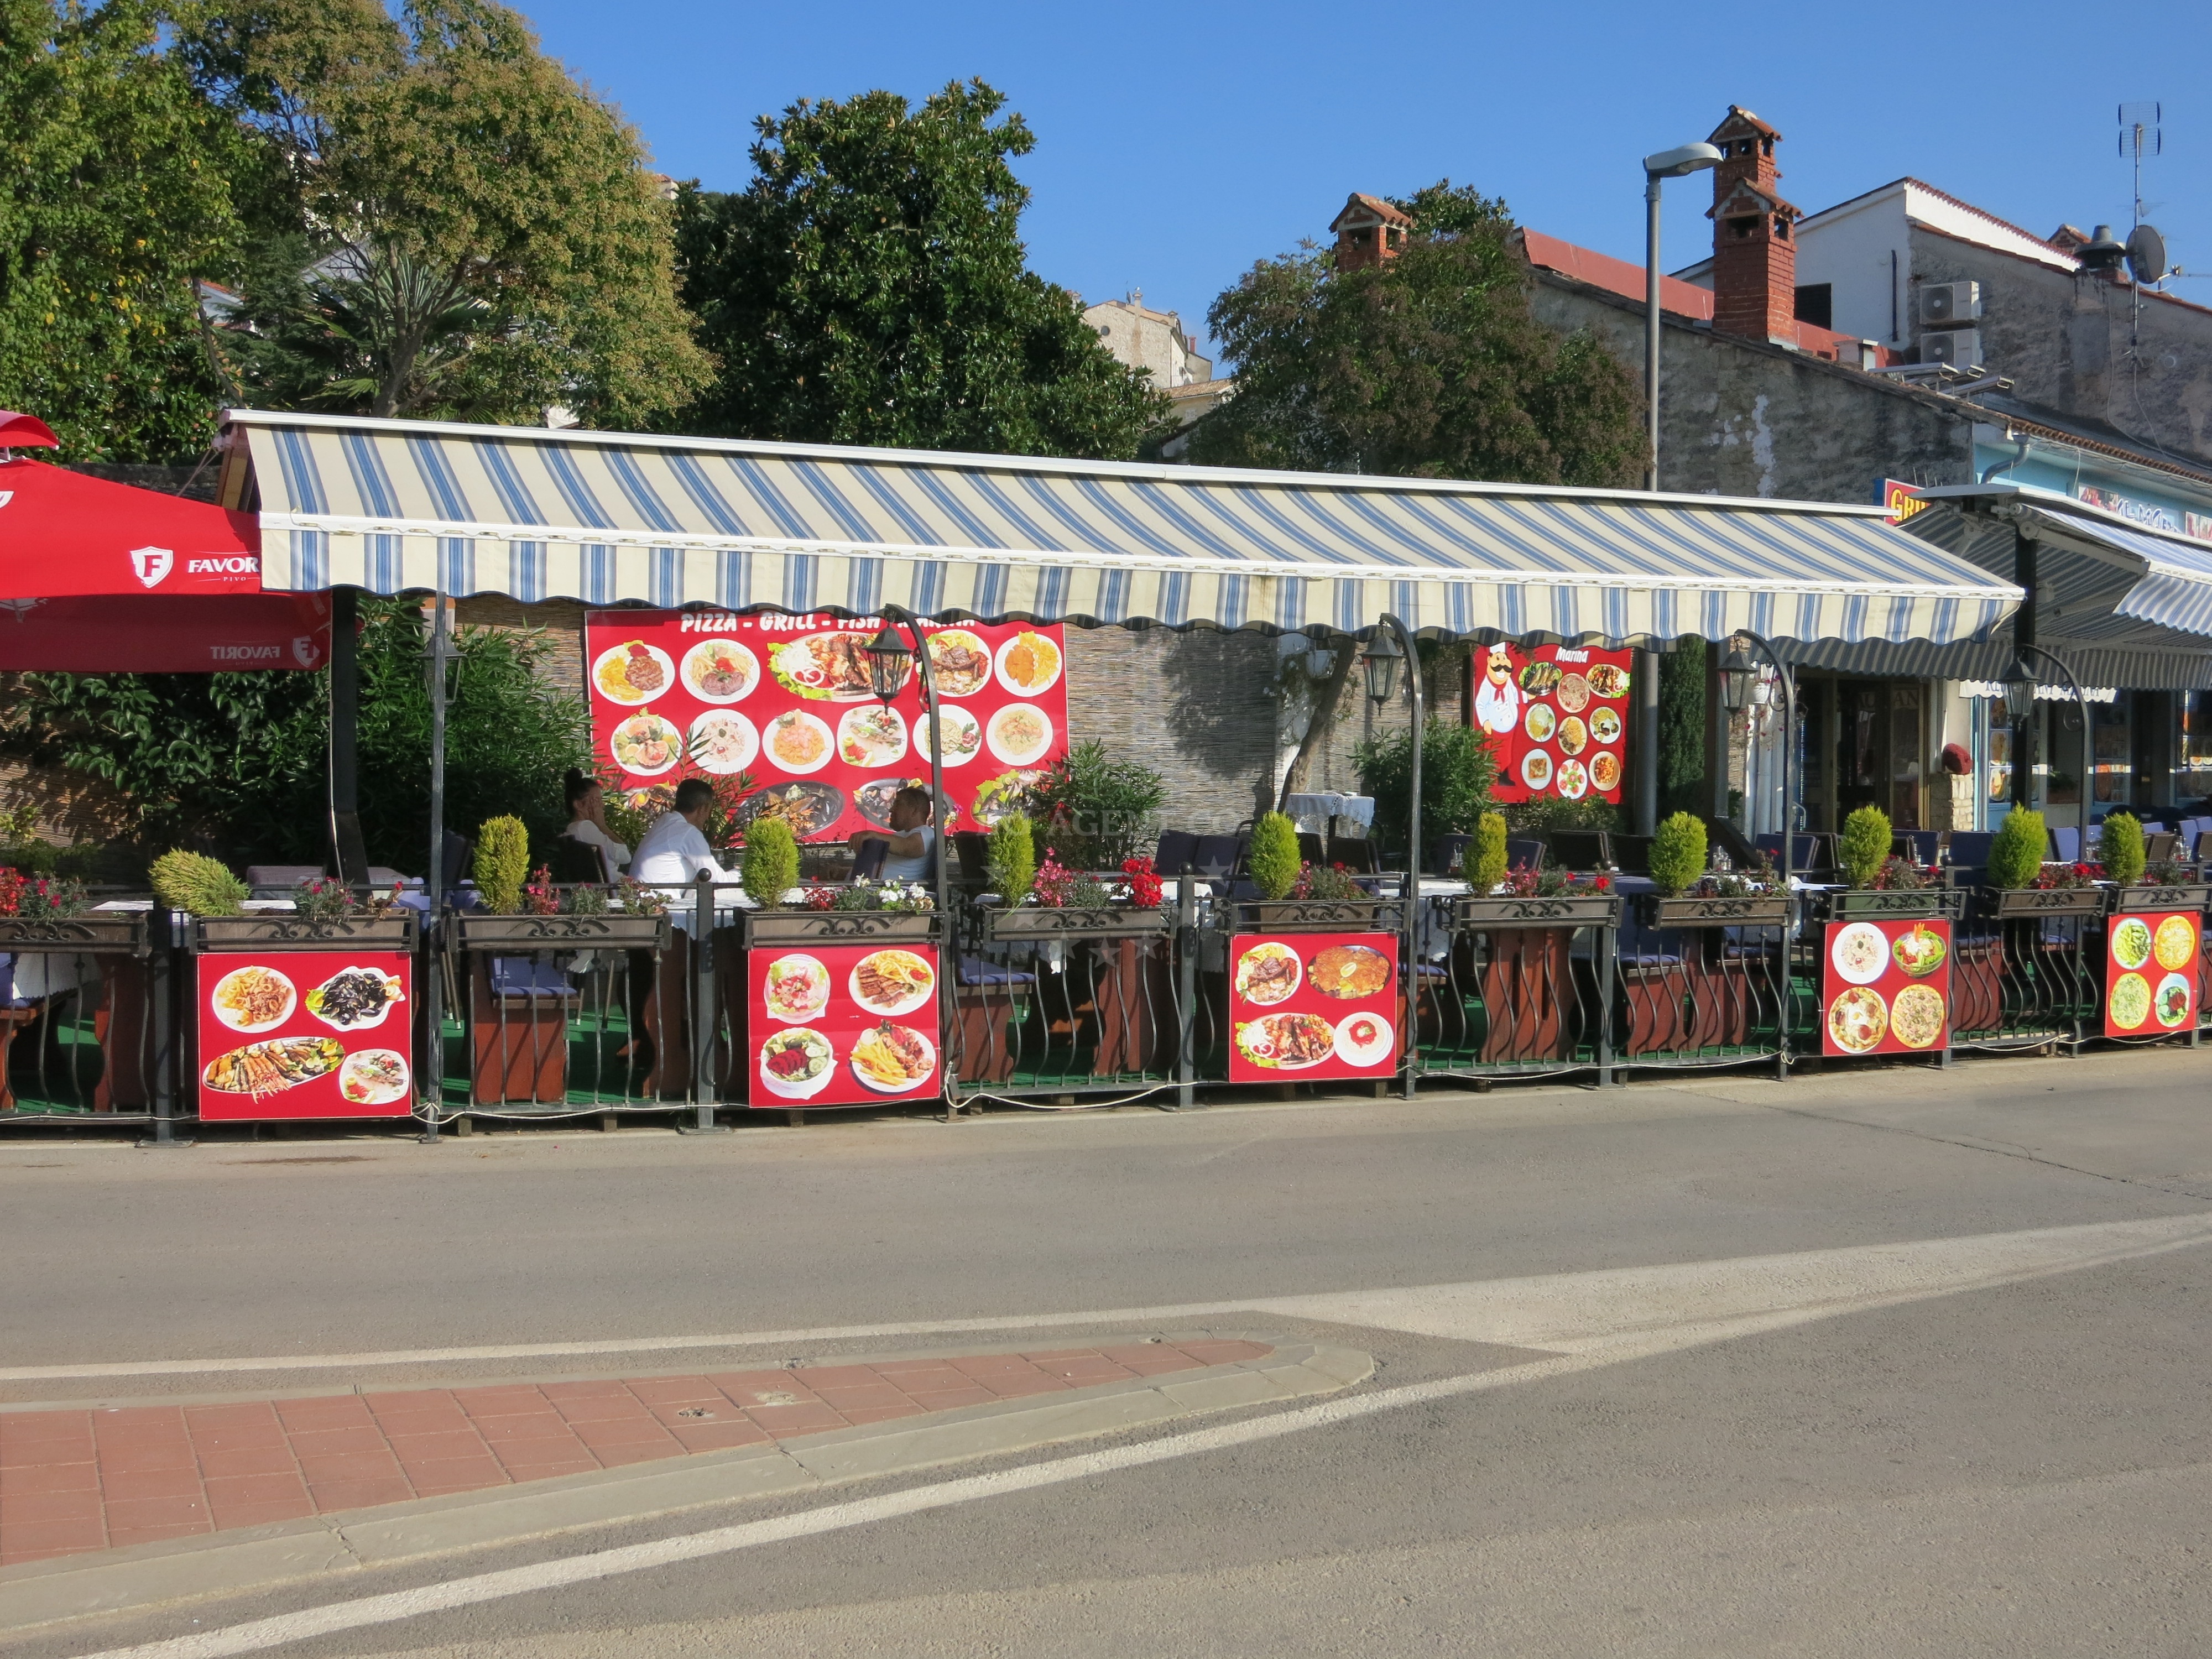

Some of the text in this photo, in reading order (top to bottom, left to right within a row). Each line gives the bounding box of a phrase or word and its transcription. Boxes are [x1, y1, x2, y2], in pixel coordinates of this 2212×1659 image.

[144, 555, 163, 578] F
[680, 613, 737, 633] PIZZA
[759, 612, 817, 632] GRILL
[1556, 646, 1589, 663] Marina
